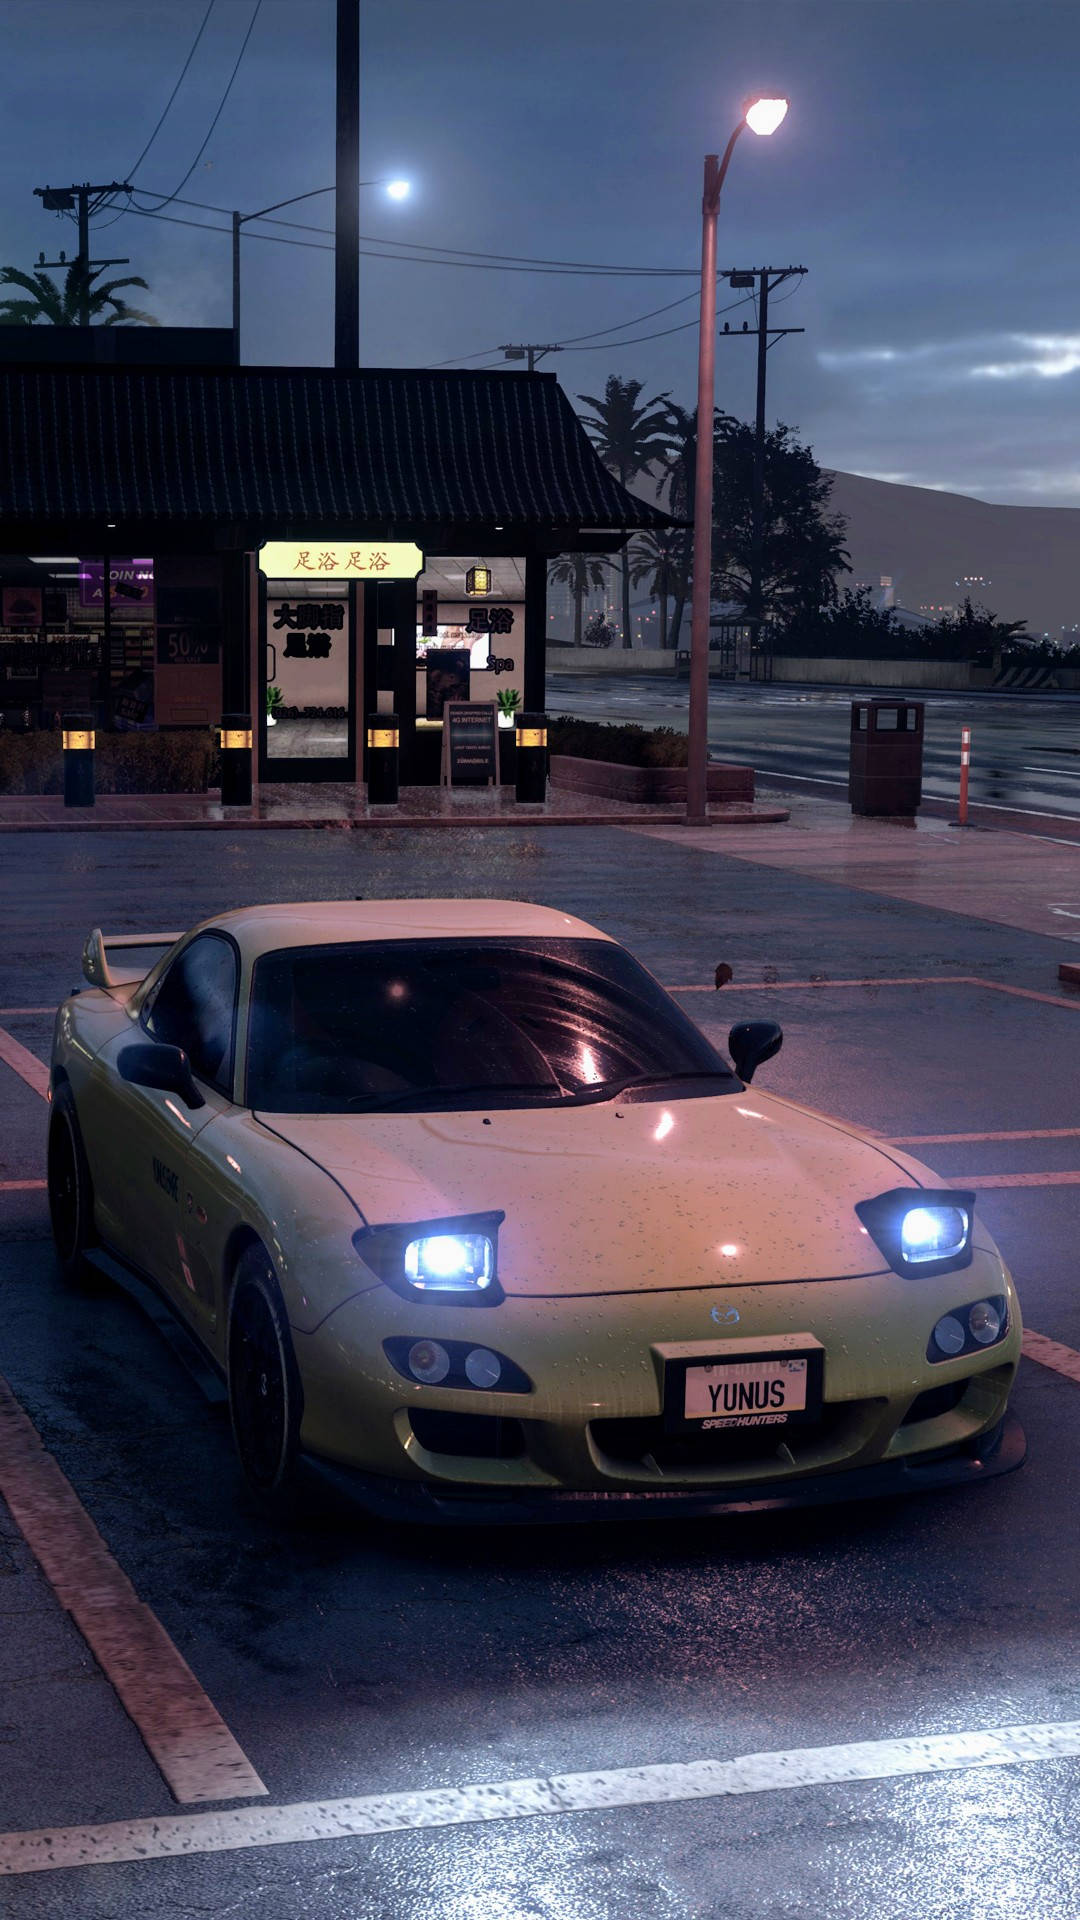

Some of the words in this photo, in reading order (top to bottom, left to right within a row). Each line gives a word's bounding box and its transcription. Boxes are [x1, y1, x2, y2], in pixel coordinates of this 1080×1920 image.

[293, 551, 390, 571] 足浴足浴
[466, 608, 514, 633] 足浴
[168, 632, 208, 658] 50%
[487, 655, 514, 675] Spa
[708, 1380, 784, 1412] YUNUS
[701, 1414, 787, 1430] SPEEDHUNTERS
